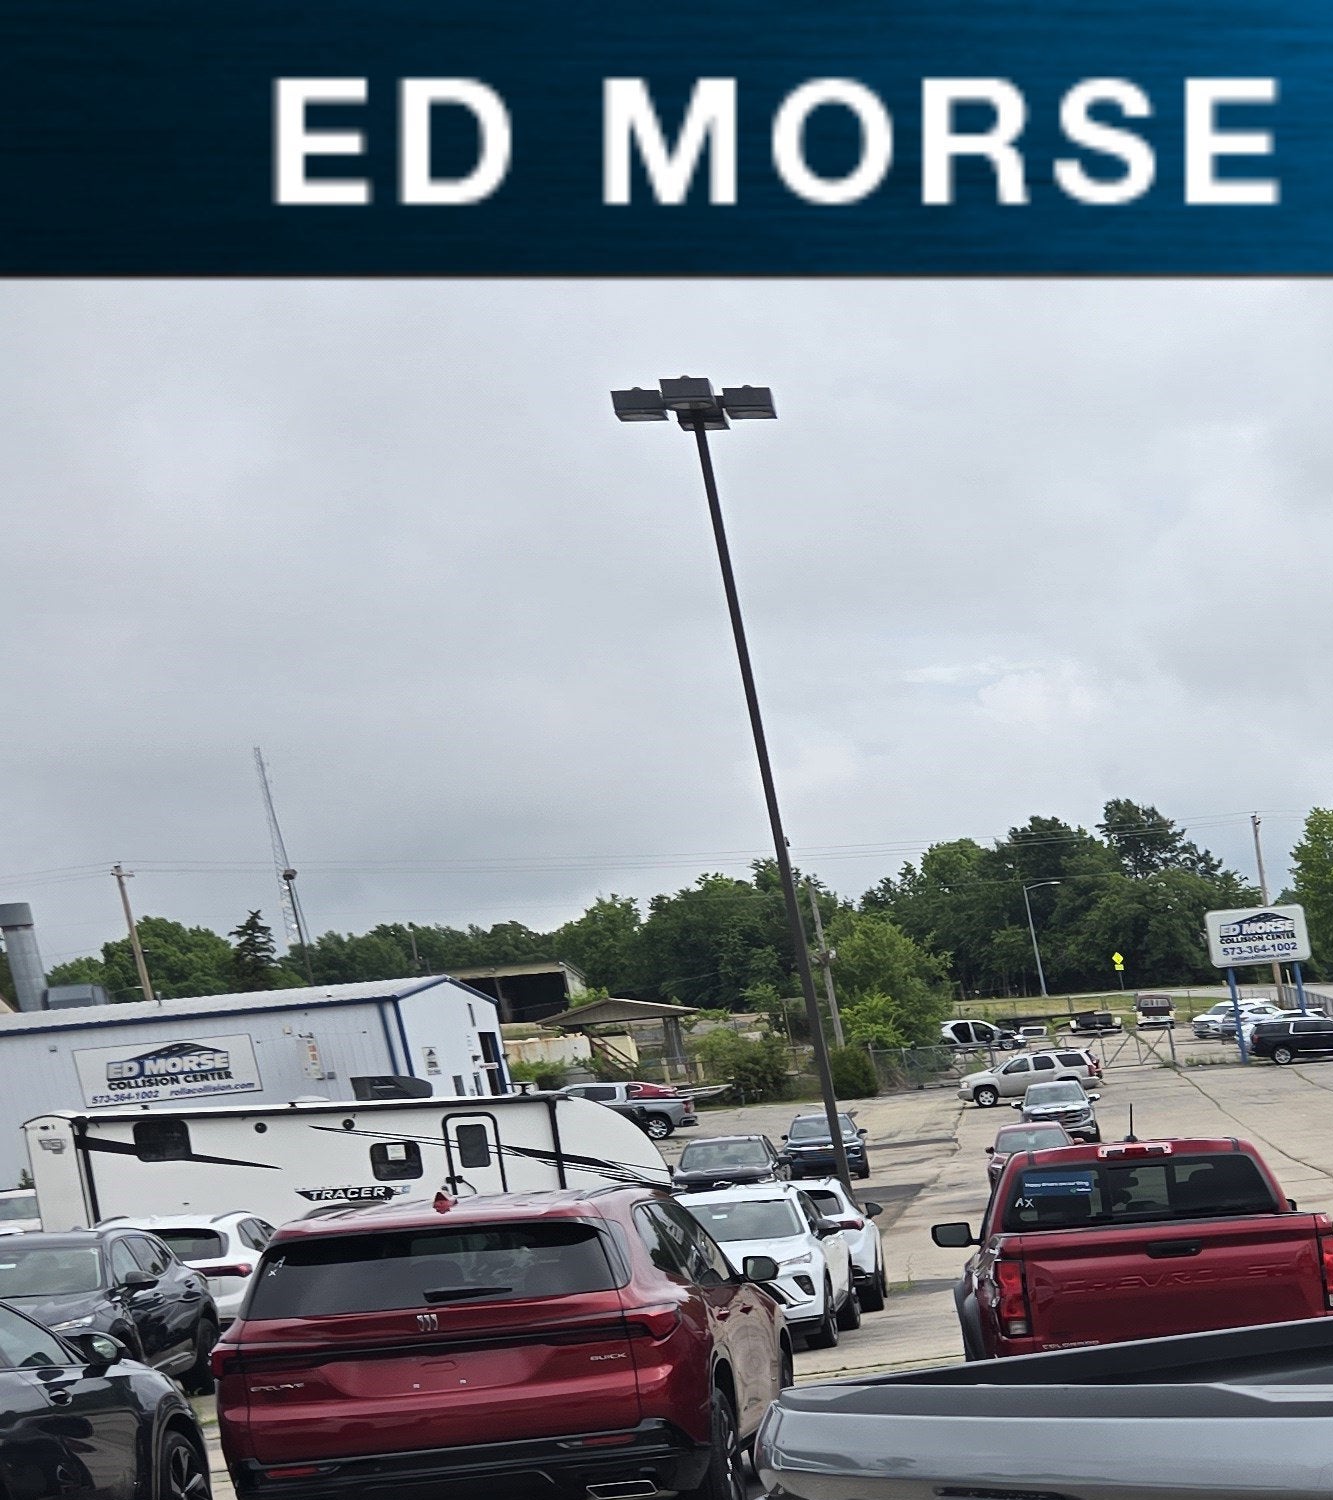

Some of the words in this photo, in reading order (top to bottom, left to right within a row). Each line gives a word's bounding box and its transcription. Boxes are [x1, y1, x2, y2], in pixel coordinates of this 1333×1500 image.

[1220, 924, 1240, 936] ED
[1241, 919, 1294, 935] MORSE
[1220, 934, 1264, 944] COLLISION
[1266, 931, 1296, 941] CENTER
[1222, 942, 1297, 956] 573-364-1002
[107, 1060, 140, 1080] ED
[143, 1051, 230, 1076] MORSE
[108, 1075, 180, 1091] COLLISION
[185, 1071, 233, 1084] CENTER
[92, 1090, 160, 1105] 573-364-1002
[169, 1082, 255, 1097] rollacollision.com
[310, 1186, 386, 1200] TRACER
